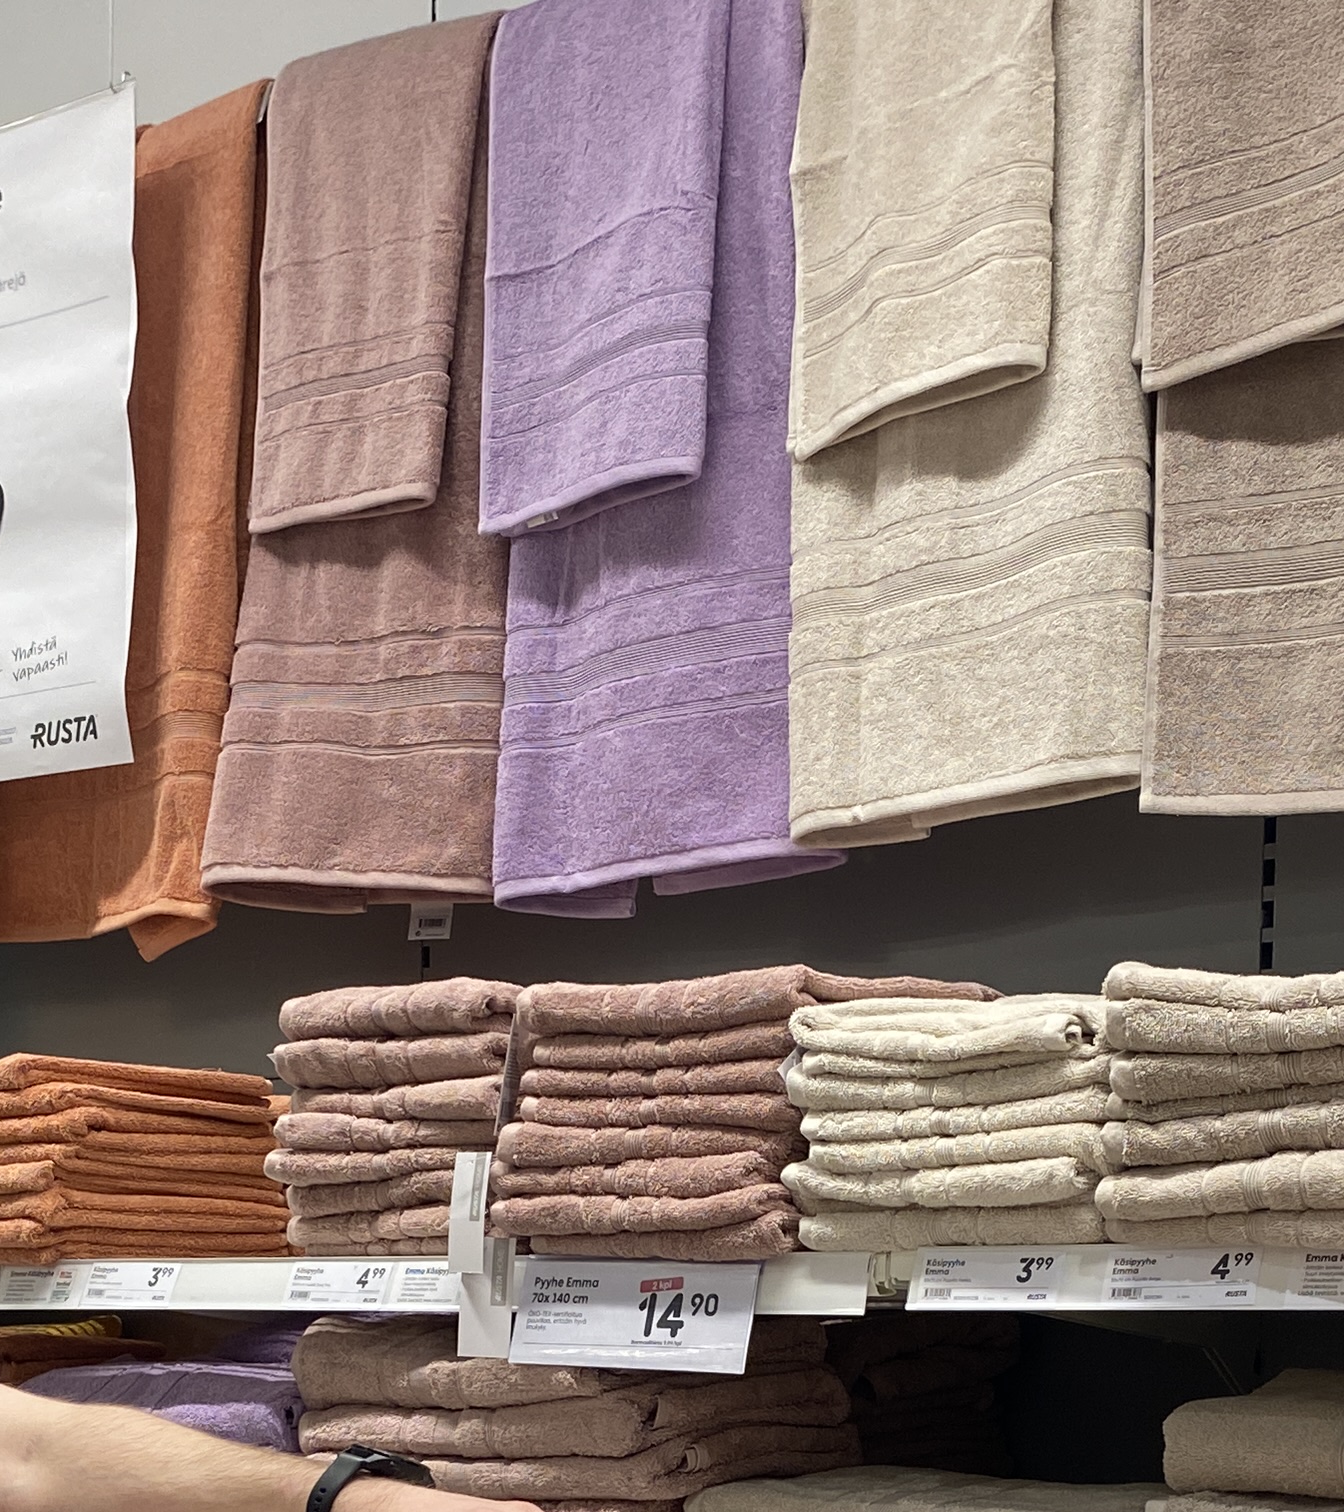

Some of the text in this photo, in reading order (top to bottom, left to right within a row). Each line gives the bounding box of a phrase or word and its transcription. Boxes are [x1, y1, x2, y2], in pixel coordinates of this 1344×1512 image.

[12, 635, 57, 662] Yhdistä
[12, 651, 69, 682] vapaasti!
[31, 715, 98, 749] RUSTA
[1114, 1258, 1157, 1267] Käsipyyhe
[1305, 1253, 1338, 1263] Emma
[1112, 1267, 1139, 1275] Emma
[534, 1277, 599, 1289] Pyyhe Emma
[652, 1280, 673, 1291] 2 kpl
[573, 1294, 589, 1304] cm
